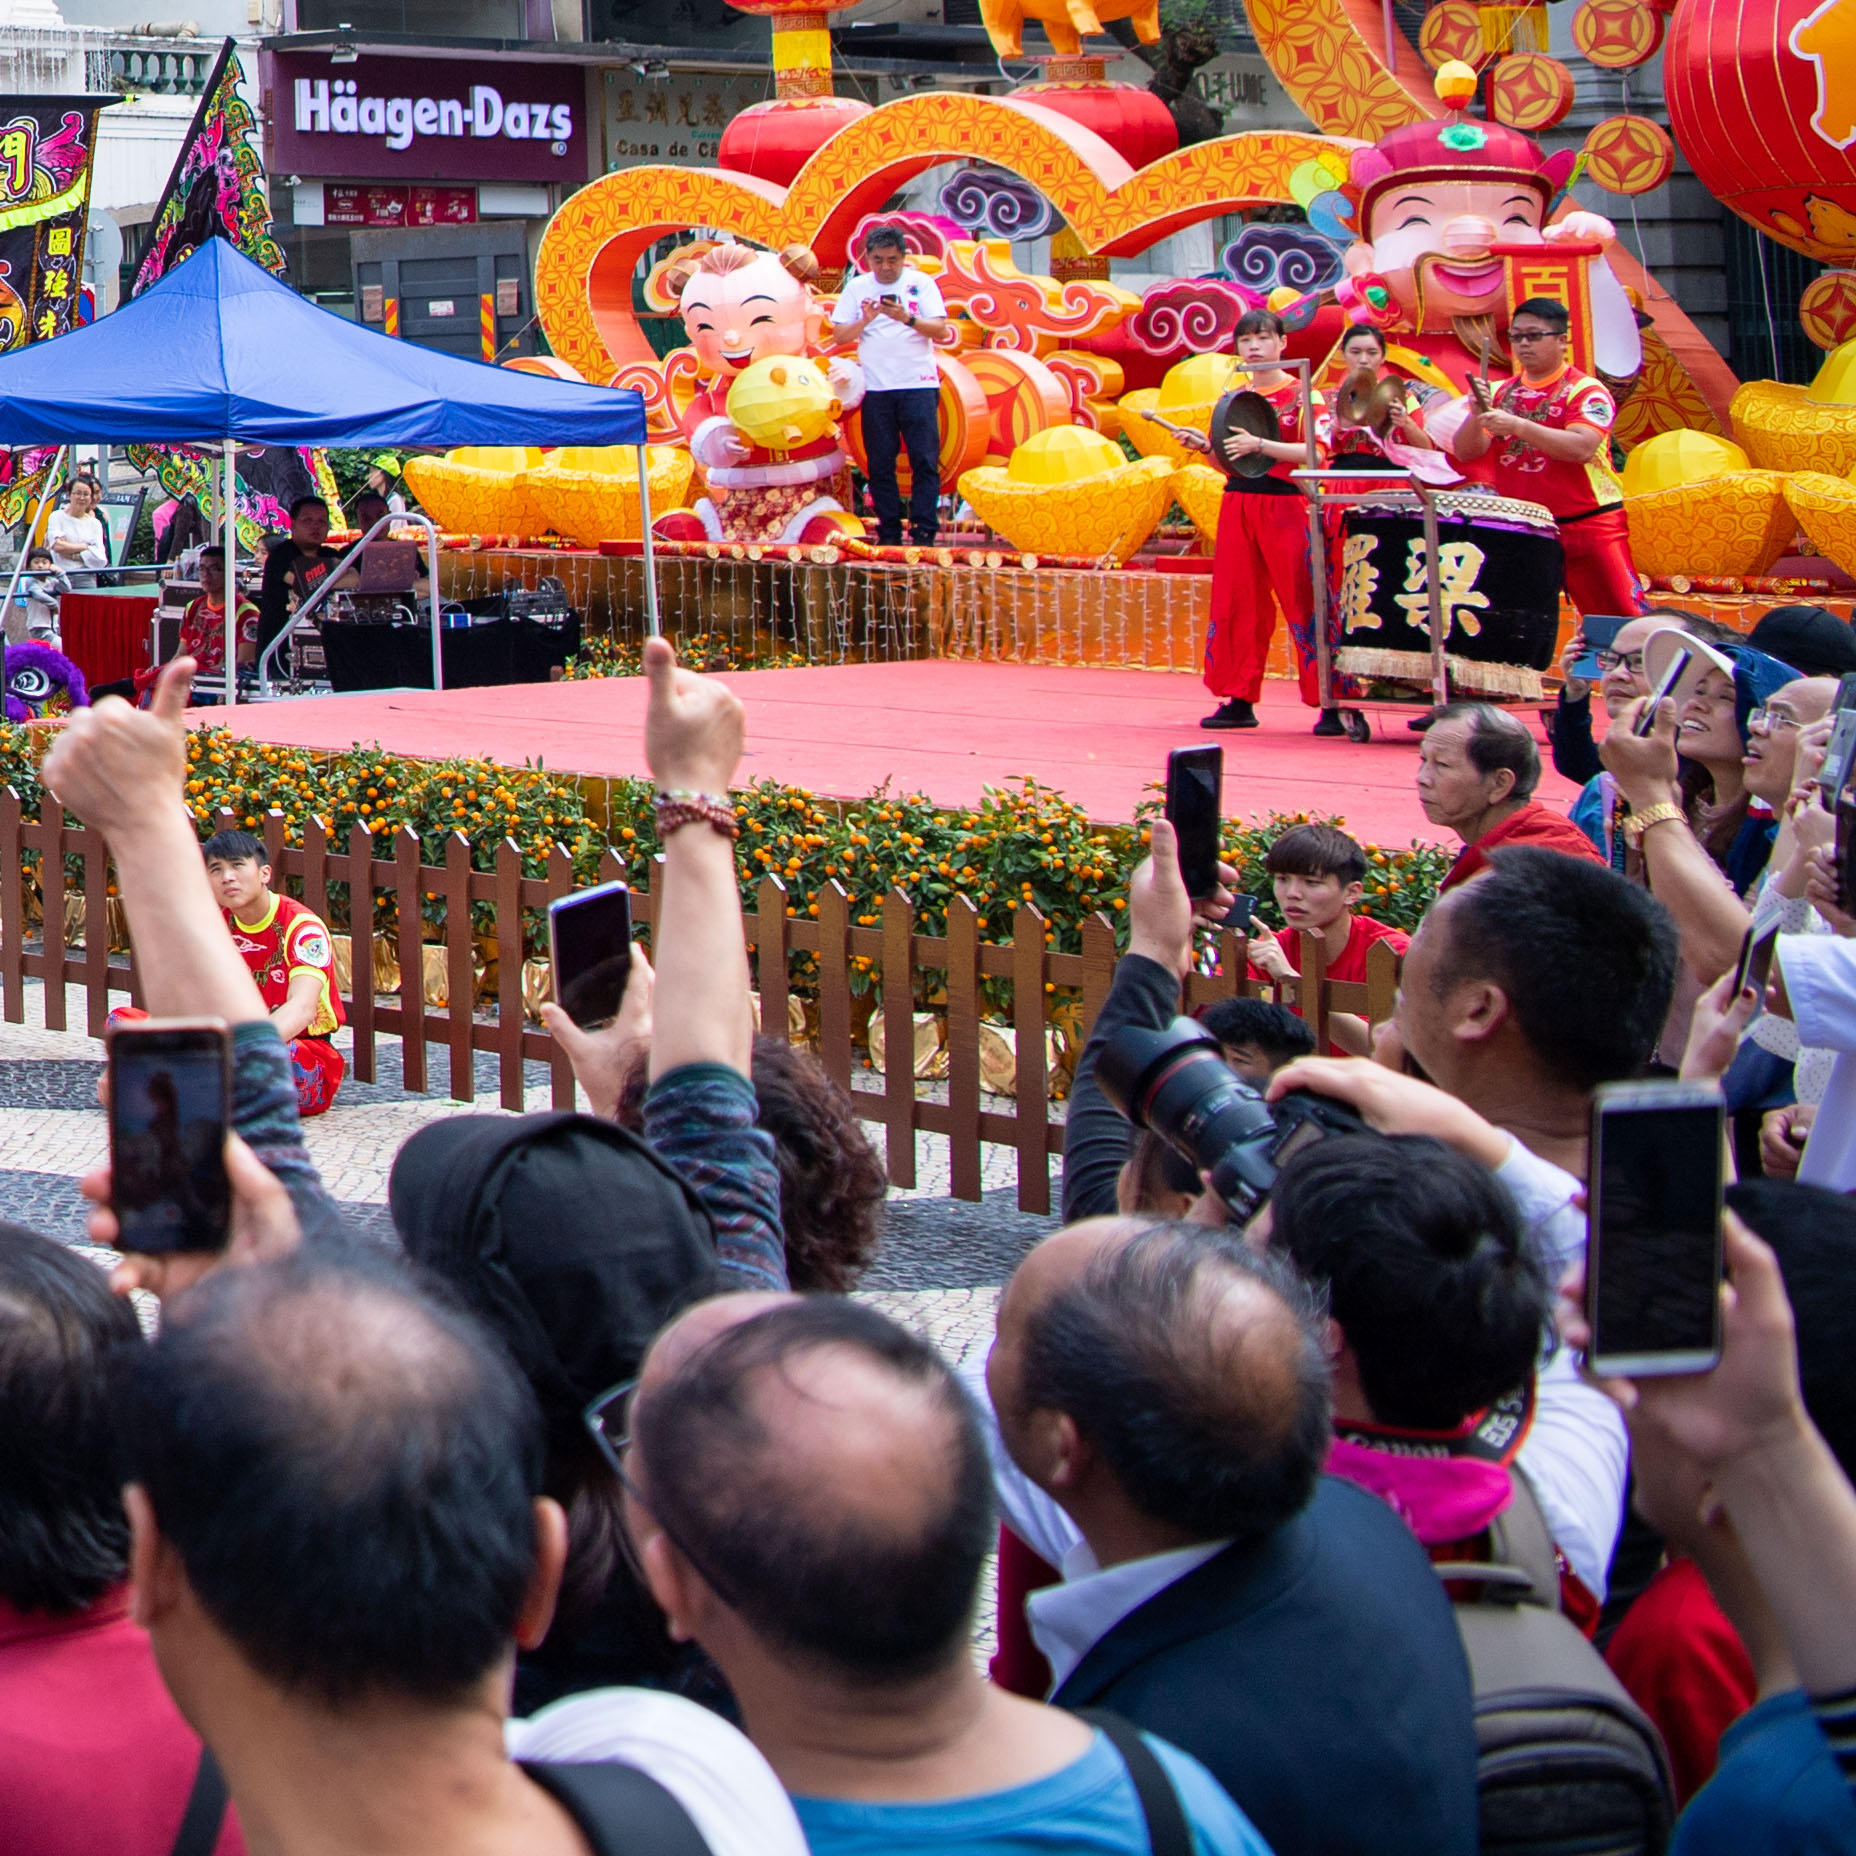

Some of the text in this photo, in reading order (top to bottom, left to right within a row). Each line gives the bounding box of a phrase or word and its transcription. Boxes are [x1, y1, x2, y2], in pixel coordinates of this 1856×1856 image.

[295, 78, 573, 151] Häagen-Dazs
[616, 139, 659, 157] Casa
[668, 140, 689, 157] de
[1478, 1412, 1519, 1449] EOS
